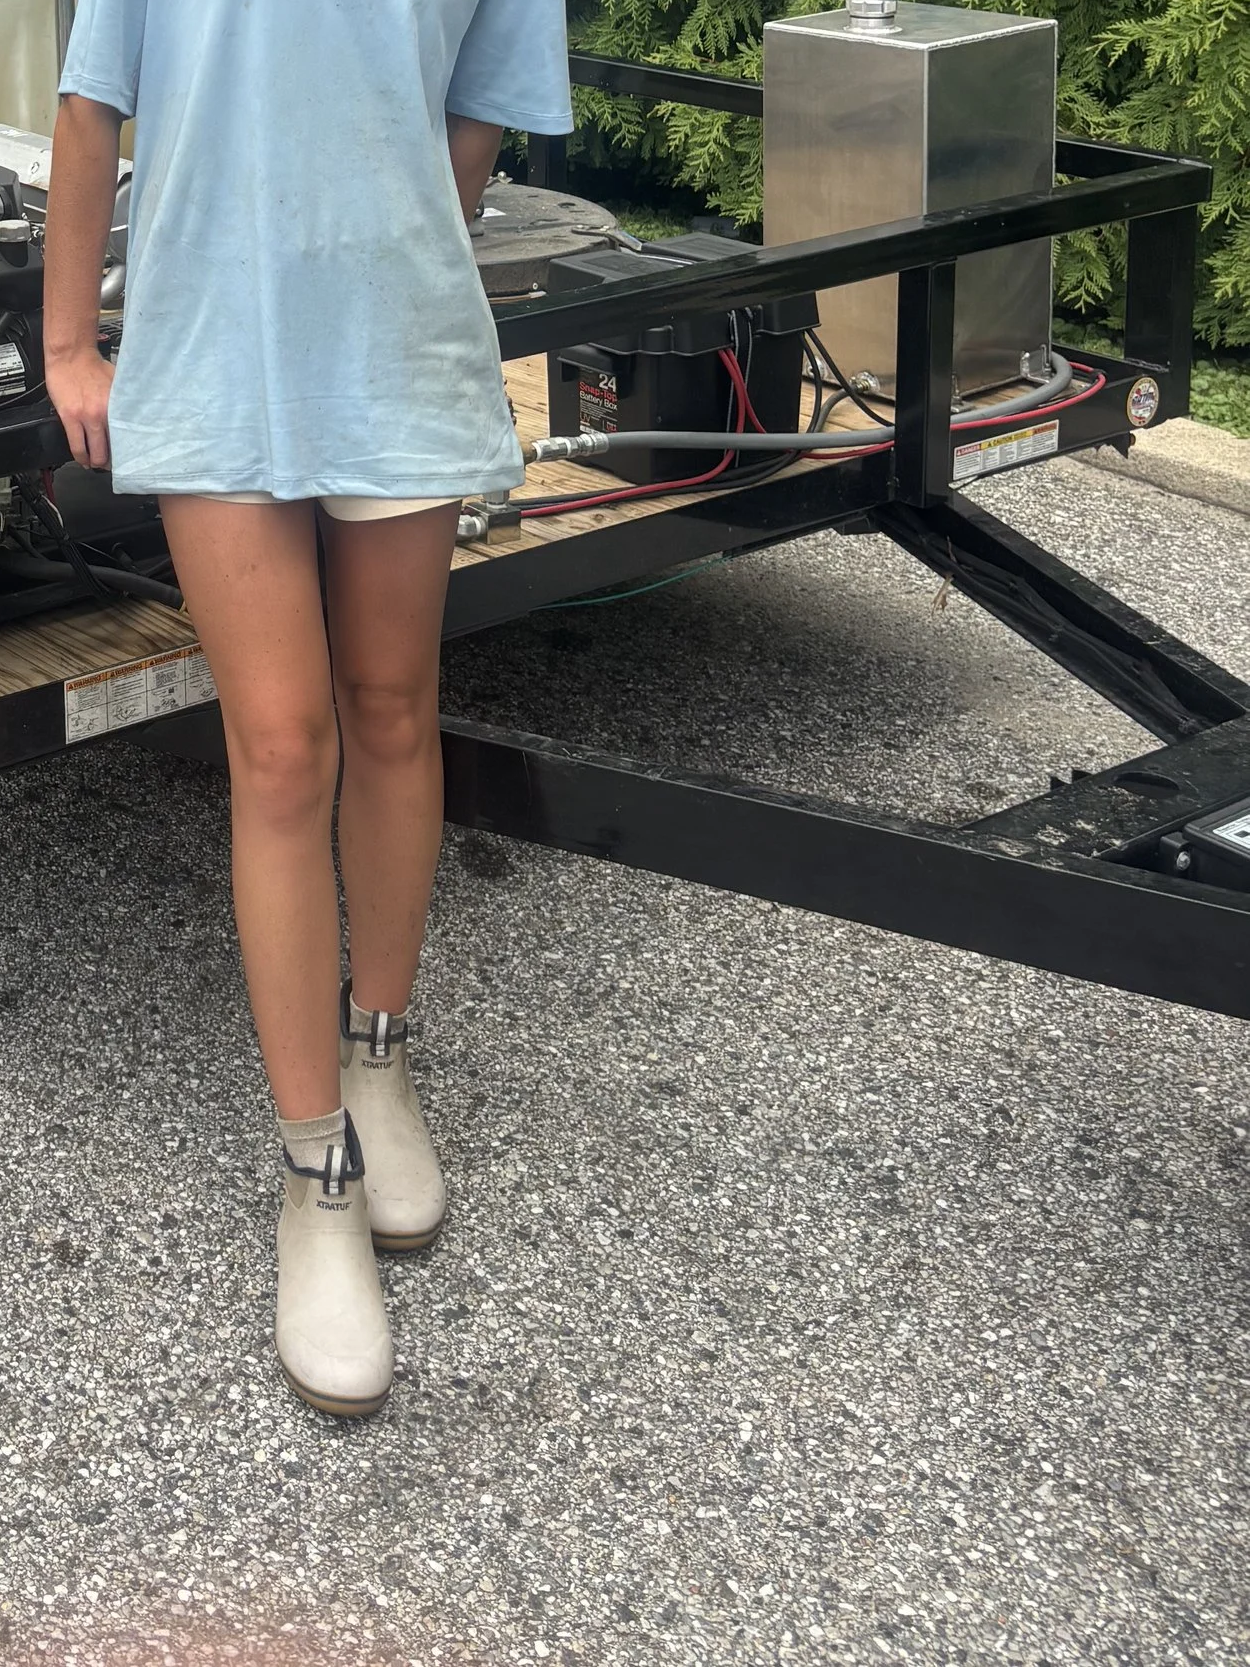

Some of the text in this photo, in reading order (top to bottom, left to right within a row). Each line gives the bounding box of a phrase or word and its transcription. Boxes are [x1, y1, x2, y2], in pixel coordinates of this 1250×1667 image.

[579, 381, 618, 404] Snap-Top
[598, 373, 617, 393] 24
[579, 390, 618, 411] Battery Box
[361, 1059, 393, 1069] XTRATUF
[316, 1199, 351, 1211] XTRATUF
